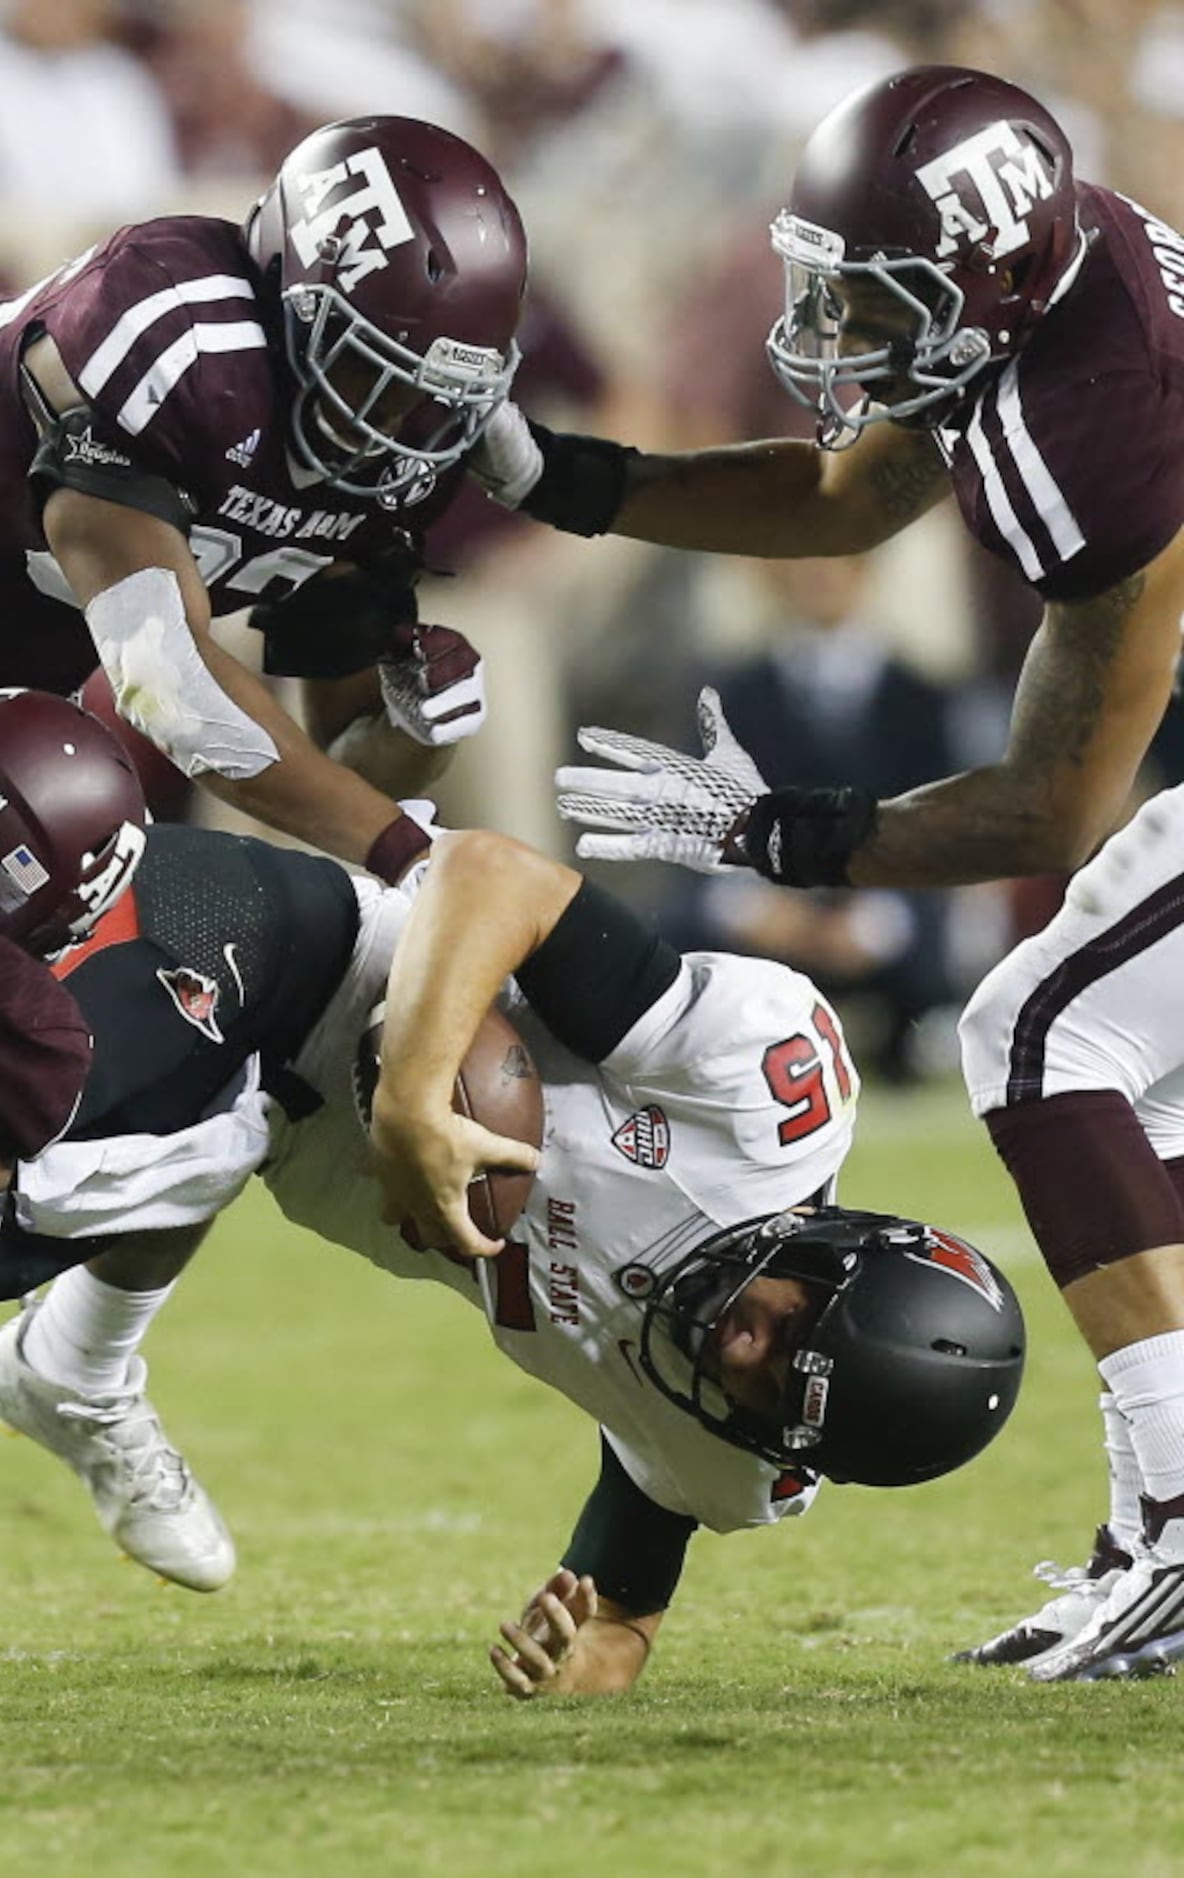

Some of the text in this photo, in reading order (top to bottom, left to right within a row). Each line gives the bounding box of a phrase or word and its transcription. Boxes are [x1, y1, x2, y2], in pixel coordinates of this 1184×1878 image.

[218, 484, 367, 540] TEXAS A&M
[547, 1197, 581, 1326] BALL STATE
